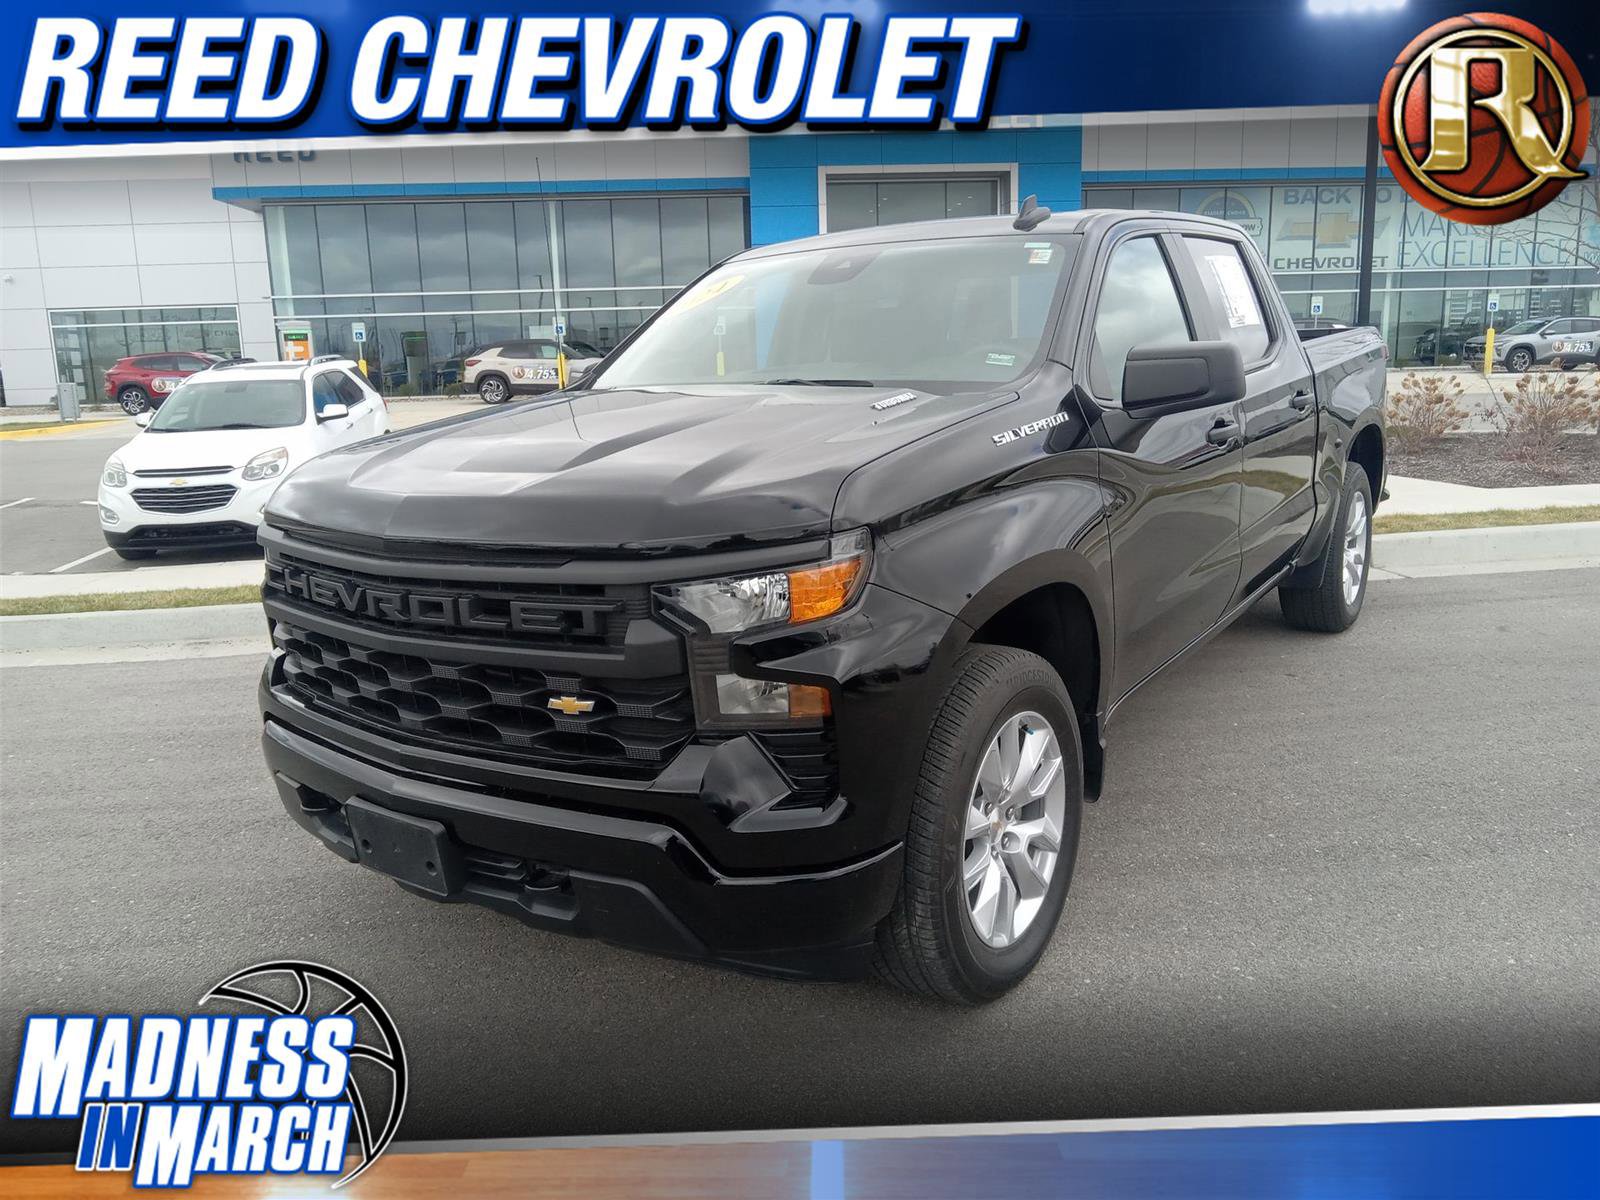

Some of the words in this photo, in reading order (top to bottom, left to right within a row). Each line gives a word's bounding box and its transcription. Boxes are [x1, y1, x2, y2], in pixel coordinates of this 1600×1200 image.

[1283, 187, 1352, 205] BACK
[1273, 255, 1389, 270] CHEVROET
[1398, 238, 1570, 268] EXCELLENCE
[991, 411, 1070, 447] SILVERADO
[266, 564, 623, 634] CHEVROLET
